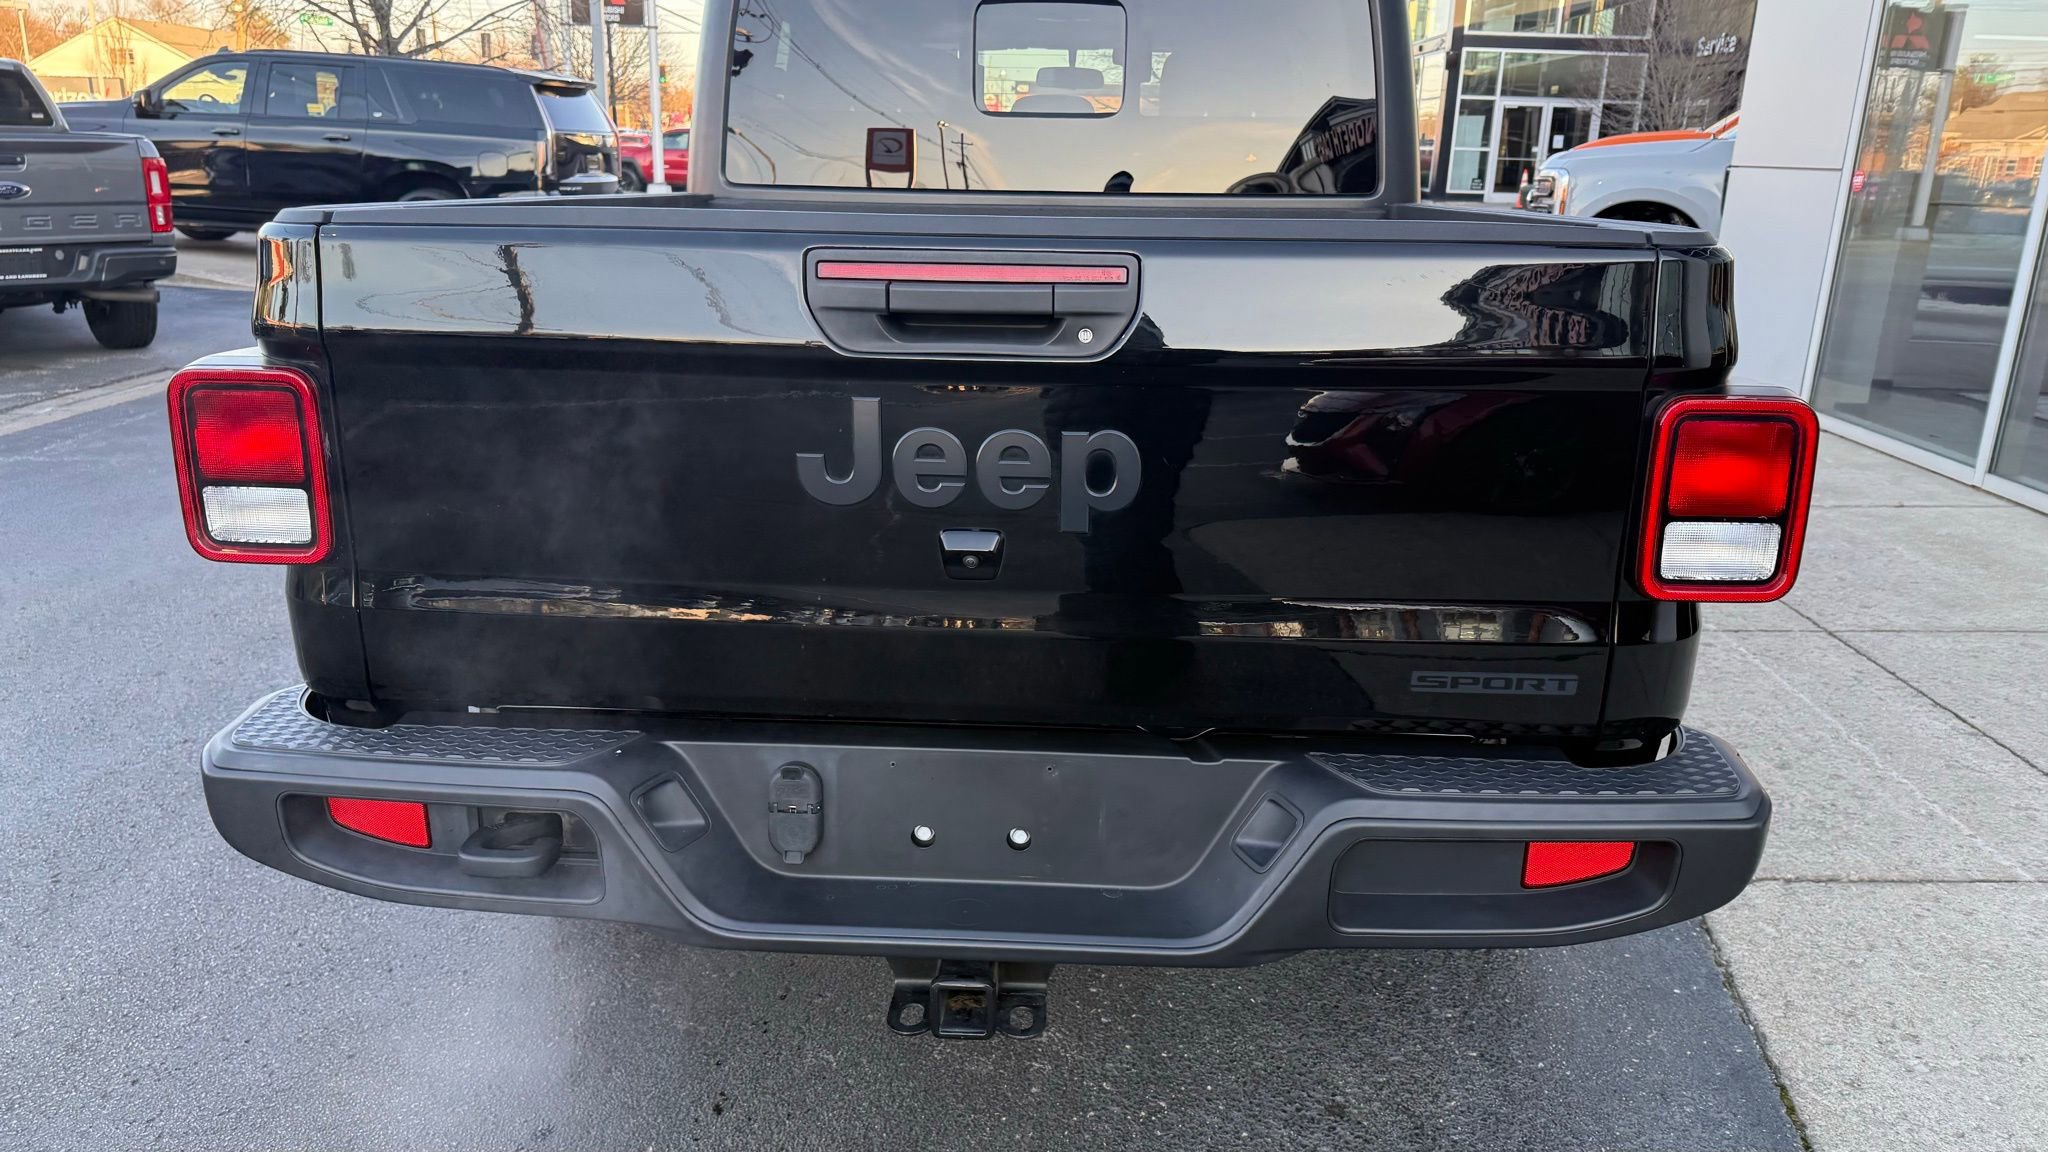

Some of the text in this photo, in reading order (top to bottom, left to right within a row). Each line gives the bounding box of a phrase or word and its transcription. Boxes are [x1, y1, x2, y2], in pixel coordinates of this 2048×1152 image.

[1696, 32, 1737, 57] Service
[0, 214, 143, 230] GER
[796, 397, 1142, 533] Jeep
[1411, 675, 1578, 692] SPORT
